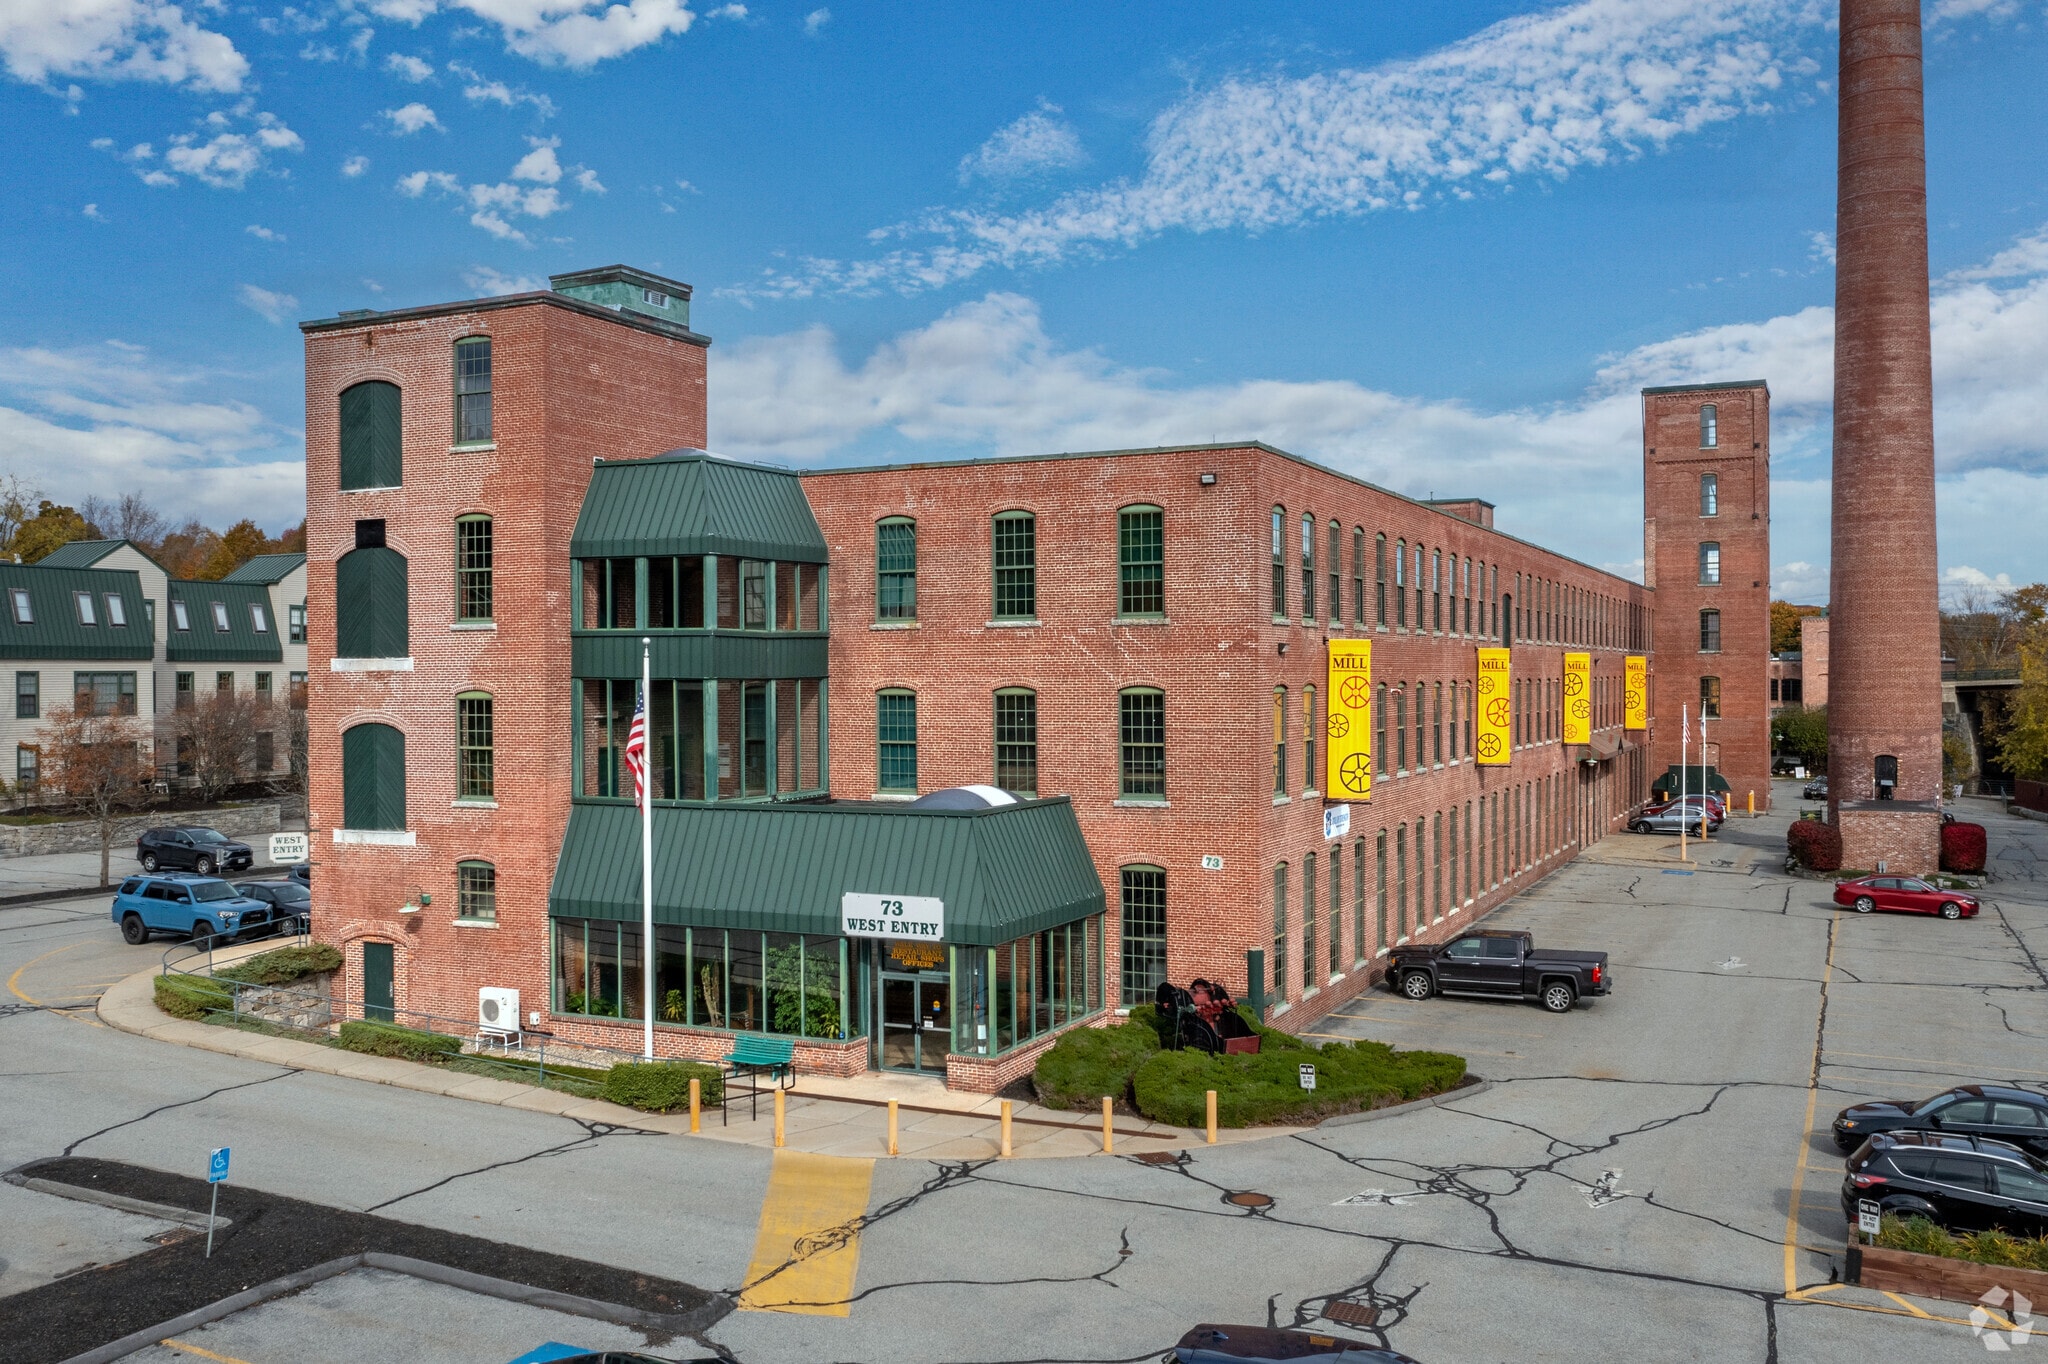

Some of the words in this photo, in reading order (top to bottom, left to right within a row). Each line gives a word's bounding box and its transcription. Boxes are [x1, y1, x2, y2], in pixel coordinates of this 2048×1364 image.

[1333, 657, 1367, 669] MILL
[1481, 661, 1507, 669] MILL
[275, 836, 302, 844] WEST
[273, 845, 304, 854] ENTRY
[1206, 856, 1220, 868] 73
[881, 900, 903, 916] 73
[847, 918, 886, 932] WEST
[891, 921, 939, 936] ENTRY
[921, 955, 945, 963] SHOPS
[902, 960, 934, 968] OFFICES
